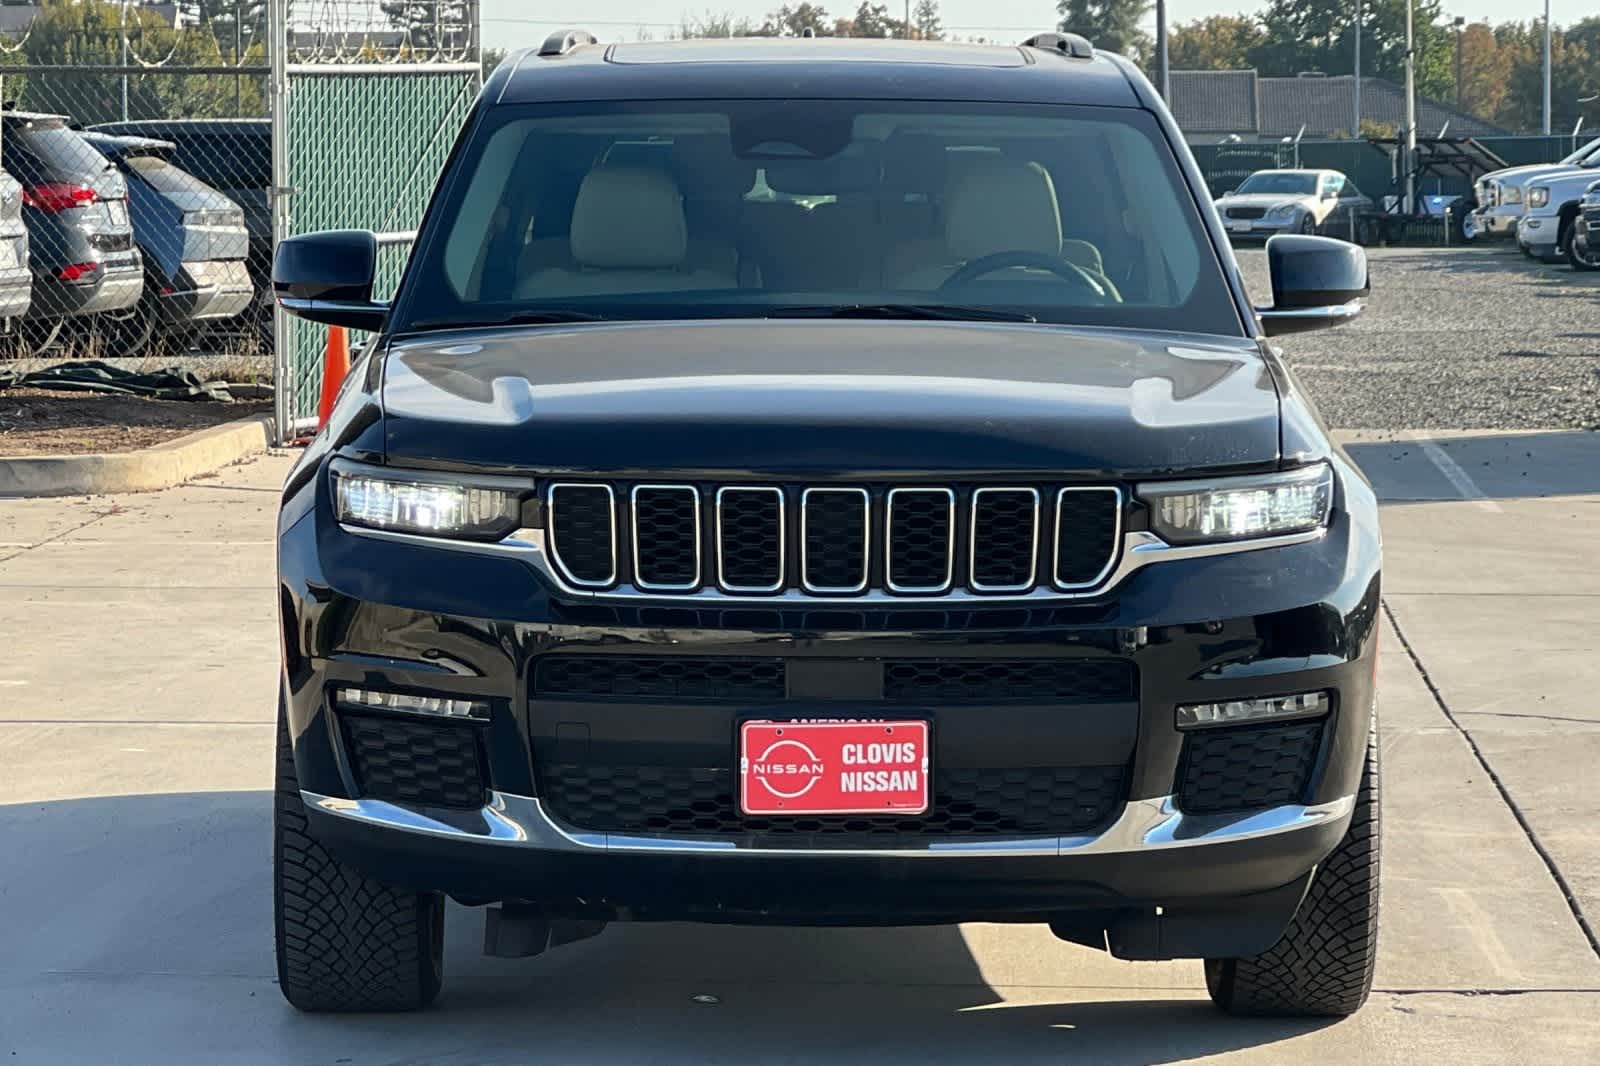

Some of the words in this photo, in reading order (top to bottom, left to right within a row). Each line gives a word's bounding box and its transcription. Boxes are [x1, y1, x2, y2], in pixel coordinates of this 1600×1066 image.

[842, 743, 916, 764] CLOVIS
[753, 764, 824, 773] NISSAN
[841, 770, 917, 792] NISSAN
